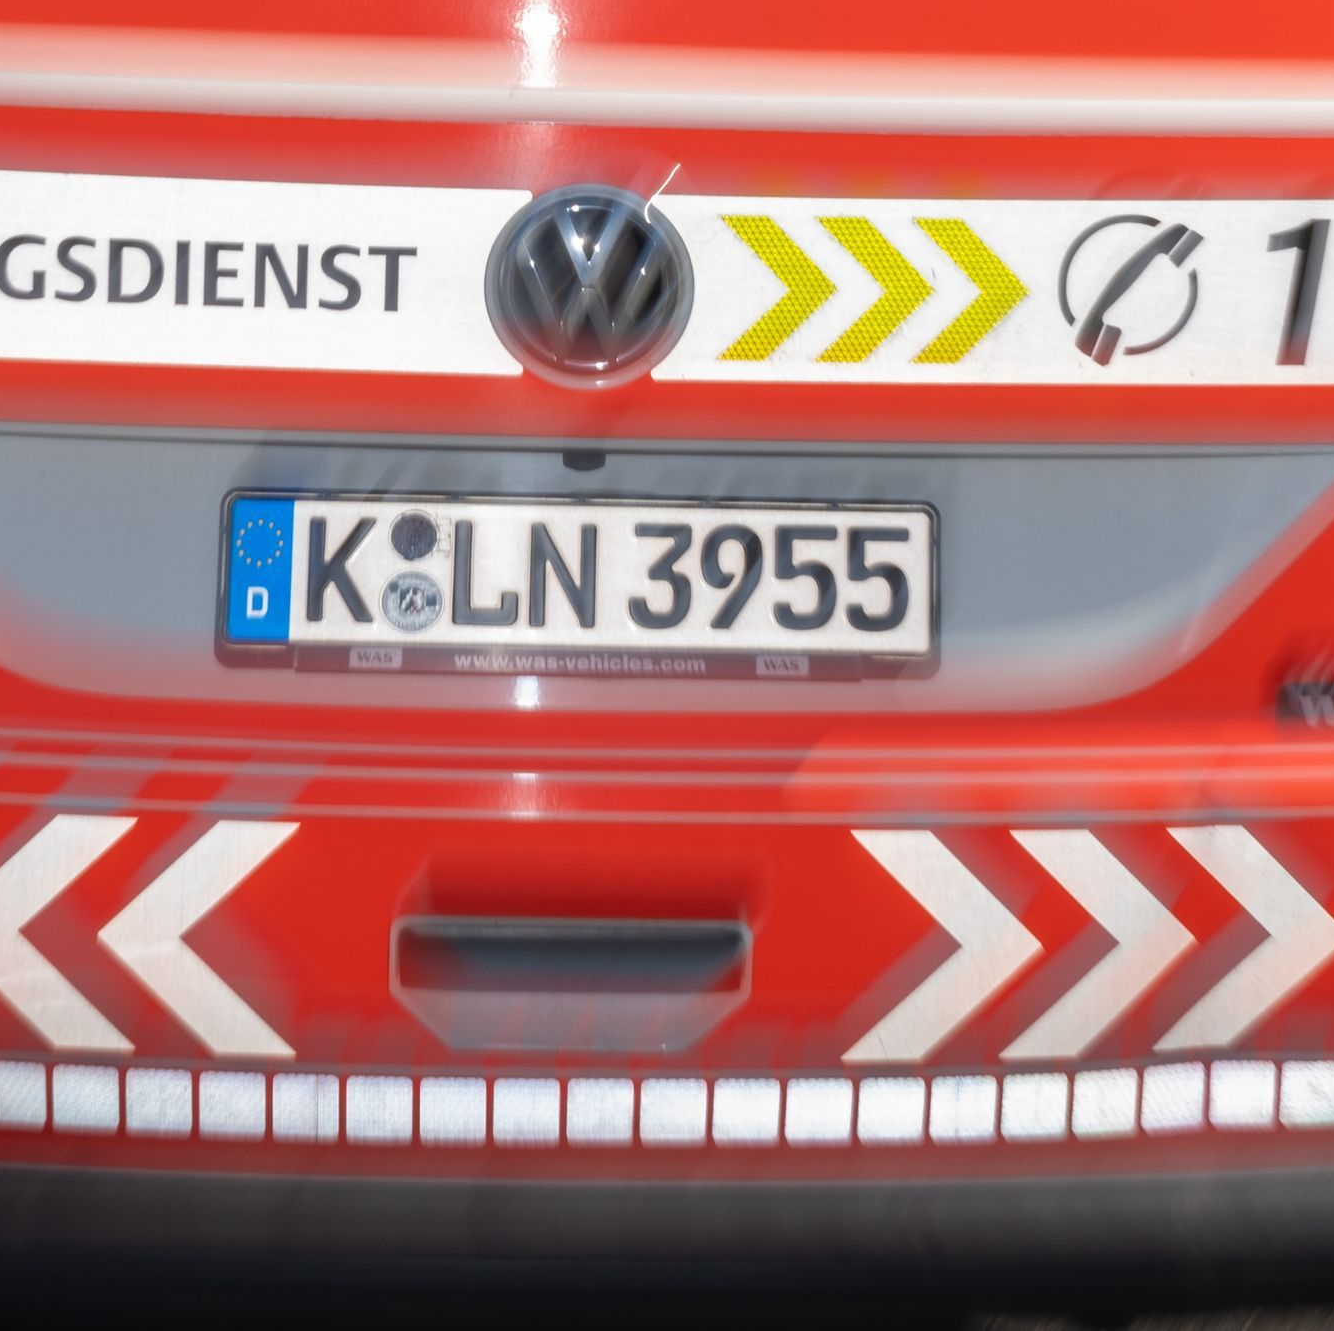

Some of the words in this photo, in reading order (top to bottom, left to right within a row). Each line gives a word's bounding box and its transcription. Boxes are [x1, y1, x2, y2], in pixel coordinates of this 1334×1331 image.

[305, 516, 378, 624] K
[451, 519, 598, 629] LN
[627, 521, 910, 633] 3955
[244, 586, 269, 618] D
[453, 651, 707, 675] www.was-vehicles.com
